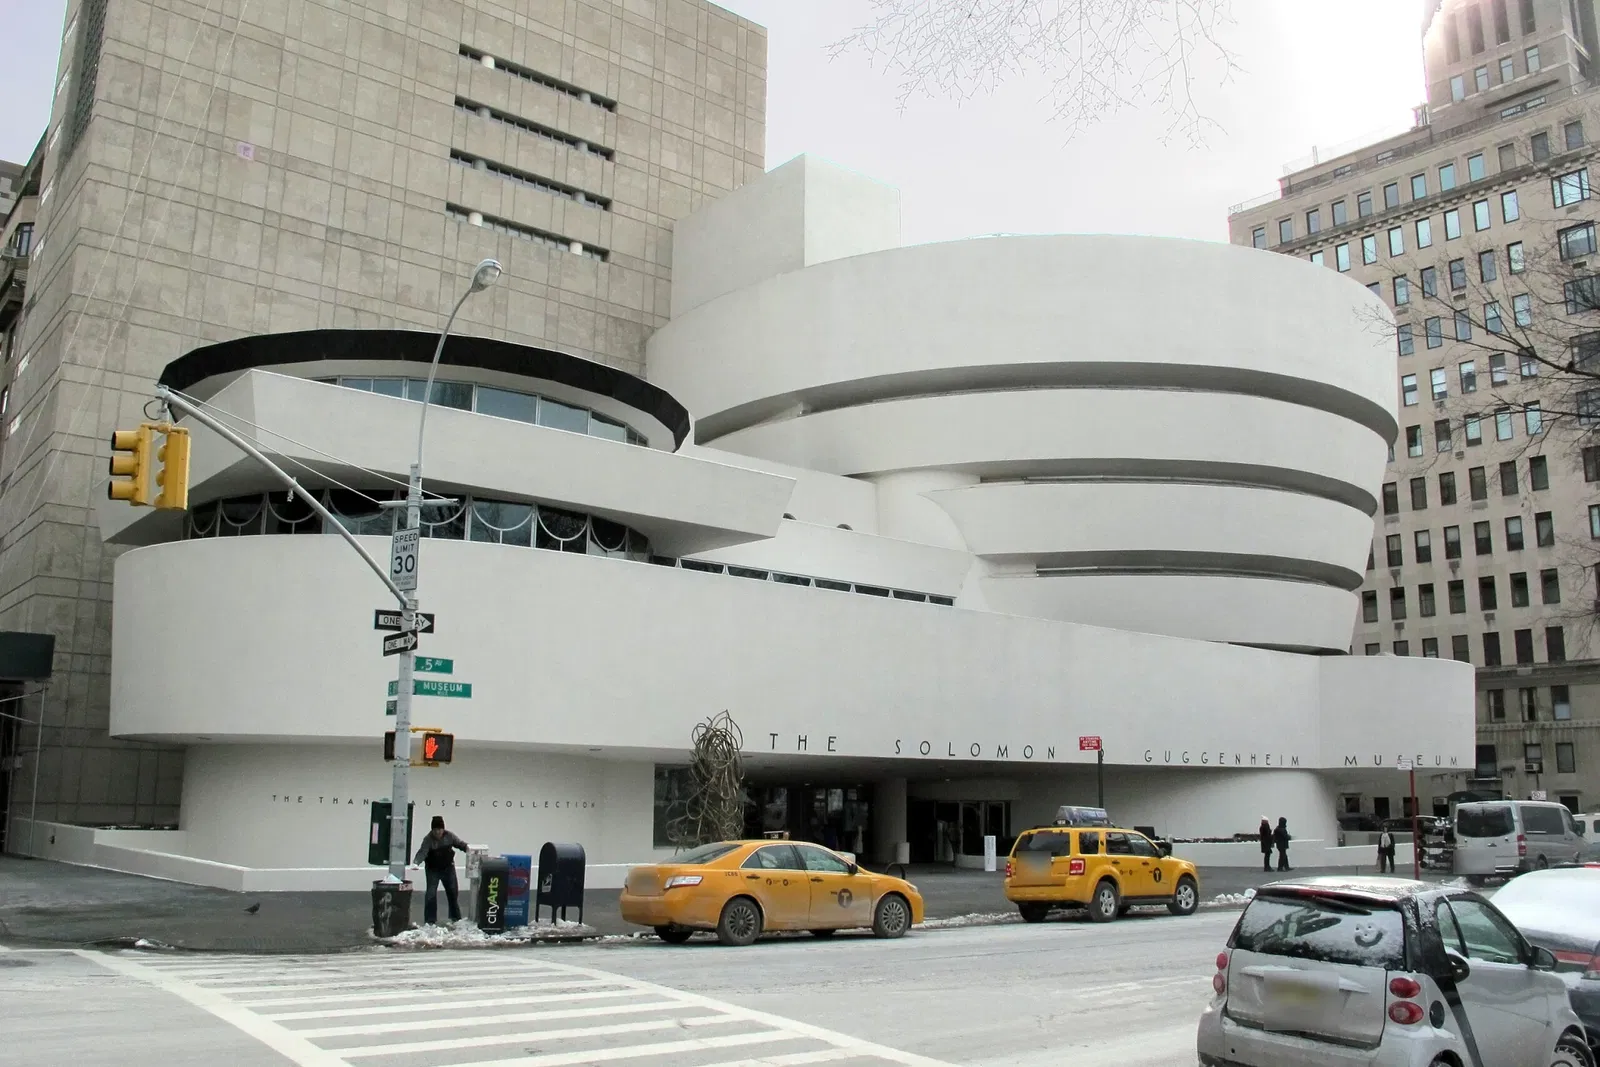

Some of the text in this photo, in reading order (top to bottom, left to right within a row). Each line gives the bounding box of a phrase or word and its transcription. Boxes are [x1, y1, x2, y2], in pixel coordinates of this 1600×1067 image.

[394, 533, 418, 543] SPEED
[395, 544, 415, 553] LIMIT
[393, 554, 415, 574] 30
[383, 616, 400, 625] ONE
[387, 636, 413, 650] ONE WAY
[425, 659, 433, 671] 5
[423, 682, 463, 693] MUSEUM
[769, 733, 836, 752] THE
[895, 739, 1055, 759] SOLOMON
[1144, 750, 1299, 766] GUGGENHEIM
[272, 794, 596, 809] THE THANAUSER COLLECTION
[486, 877, 500, 924] cityArts
